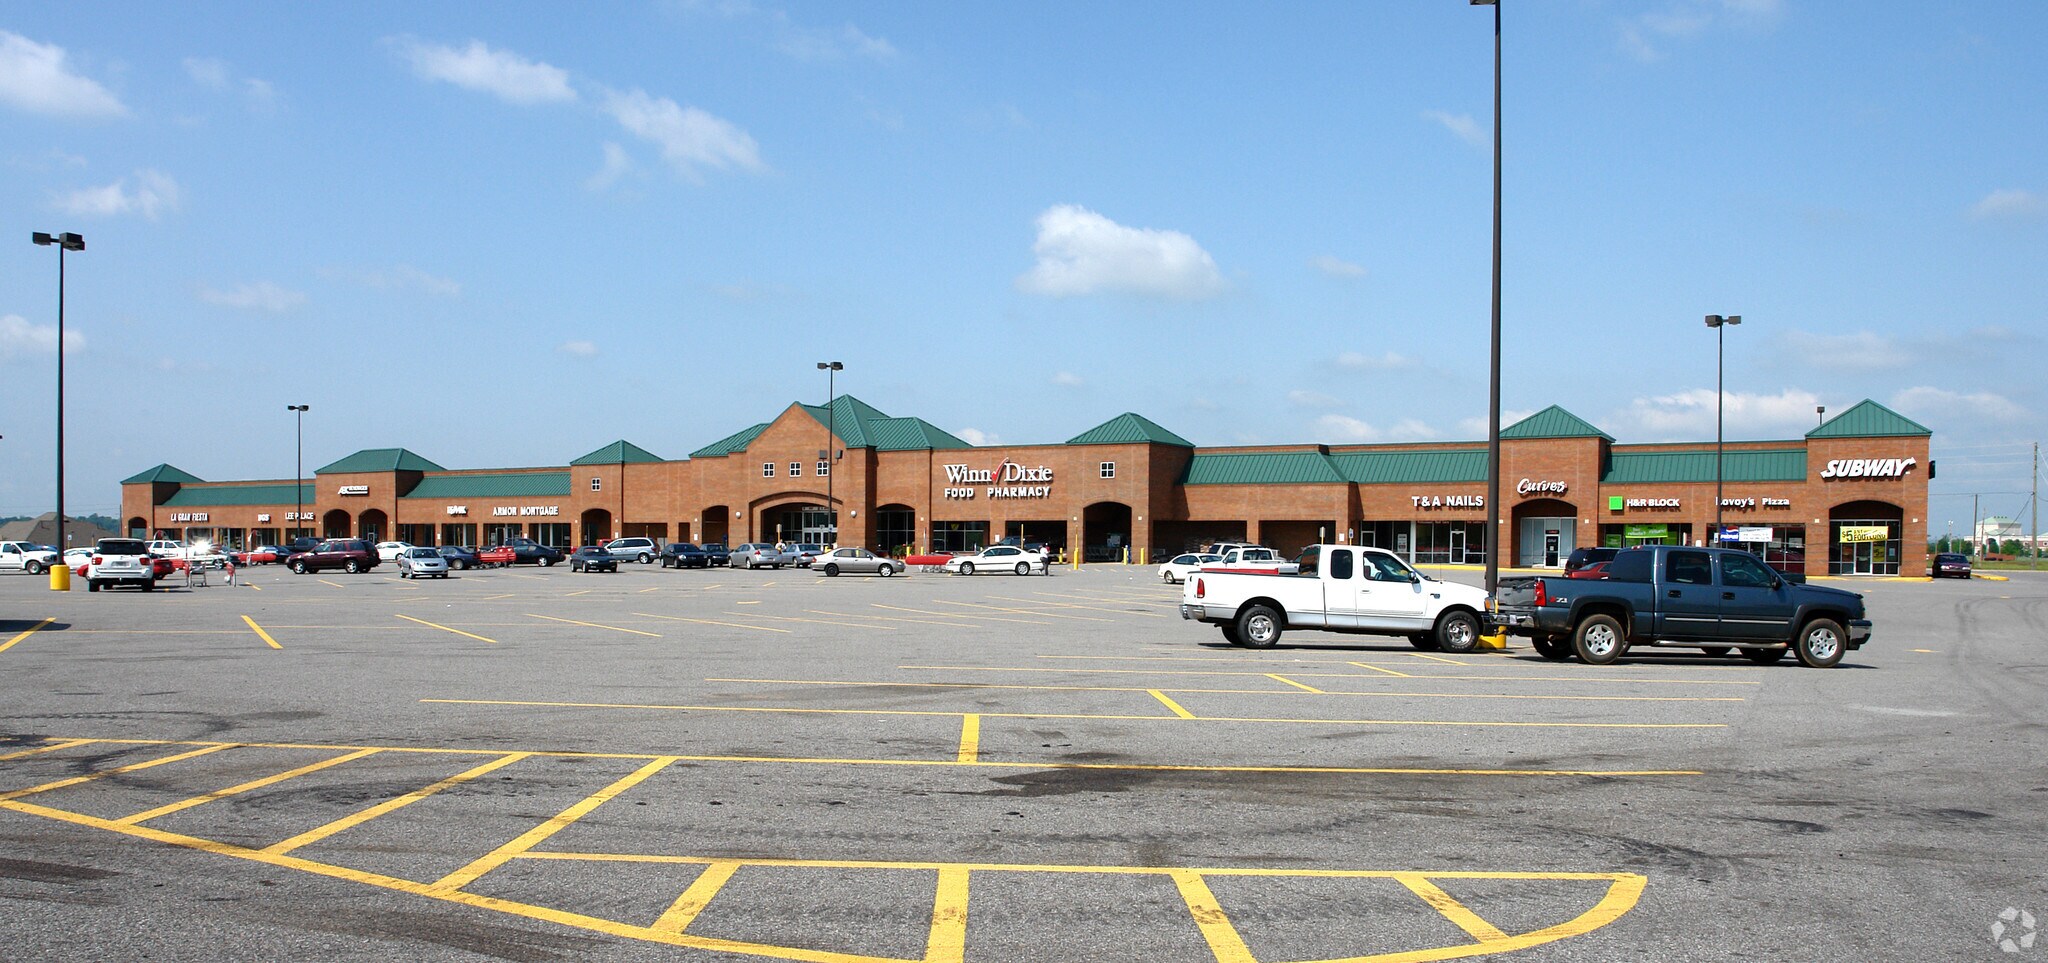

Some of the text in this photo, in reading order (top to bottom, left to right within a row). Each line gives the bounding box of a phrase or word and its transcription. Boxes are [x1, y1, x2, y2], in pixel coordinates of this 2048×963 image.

[943, 462, 1053, 483] Winn Dixie
[1820, 457, 1917, 478] SUBWAY
[1516, 478, 1567, 494] Curves
[944, 486, 1050, 498] FOOD PHARMACY
[1446, 495, 1484, 507] NAILS
[1626, 498, 1680, 507] H&R BLOCK
[1762, 497, 1790, 506] Pizza
[285, 512, 314, 520] LEE PLACE
[493, 506, 559, 516] ARMOR MORTGAGE
[170, 513, 177, 521] LA
[192, 513, 208, 521] FIESTA
